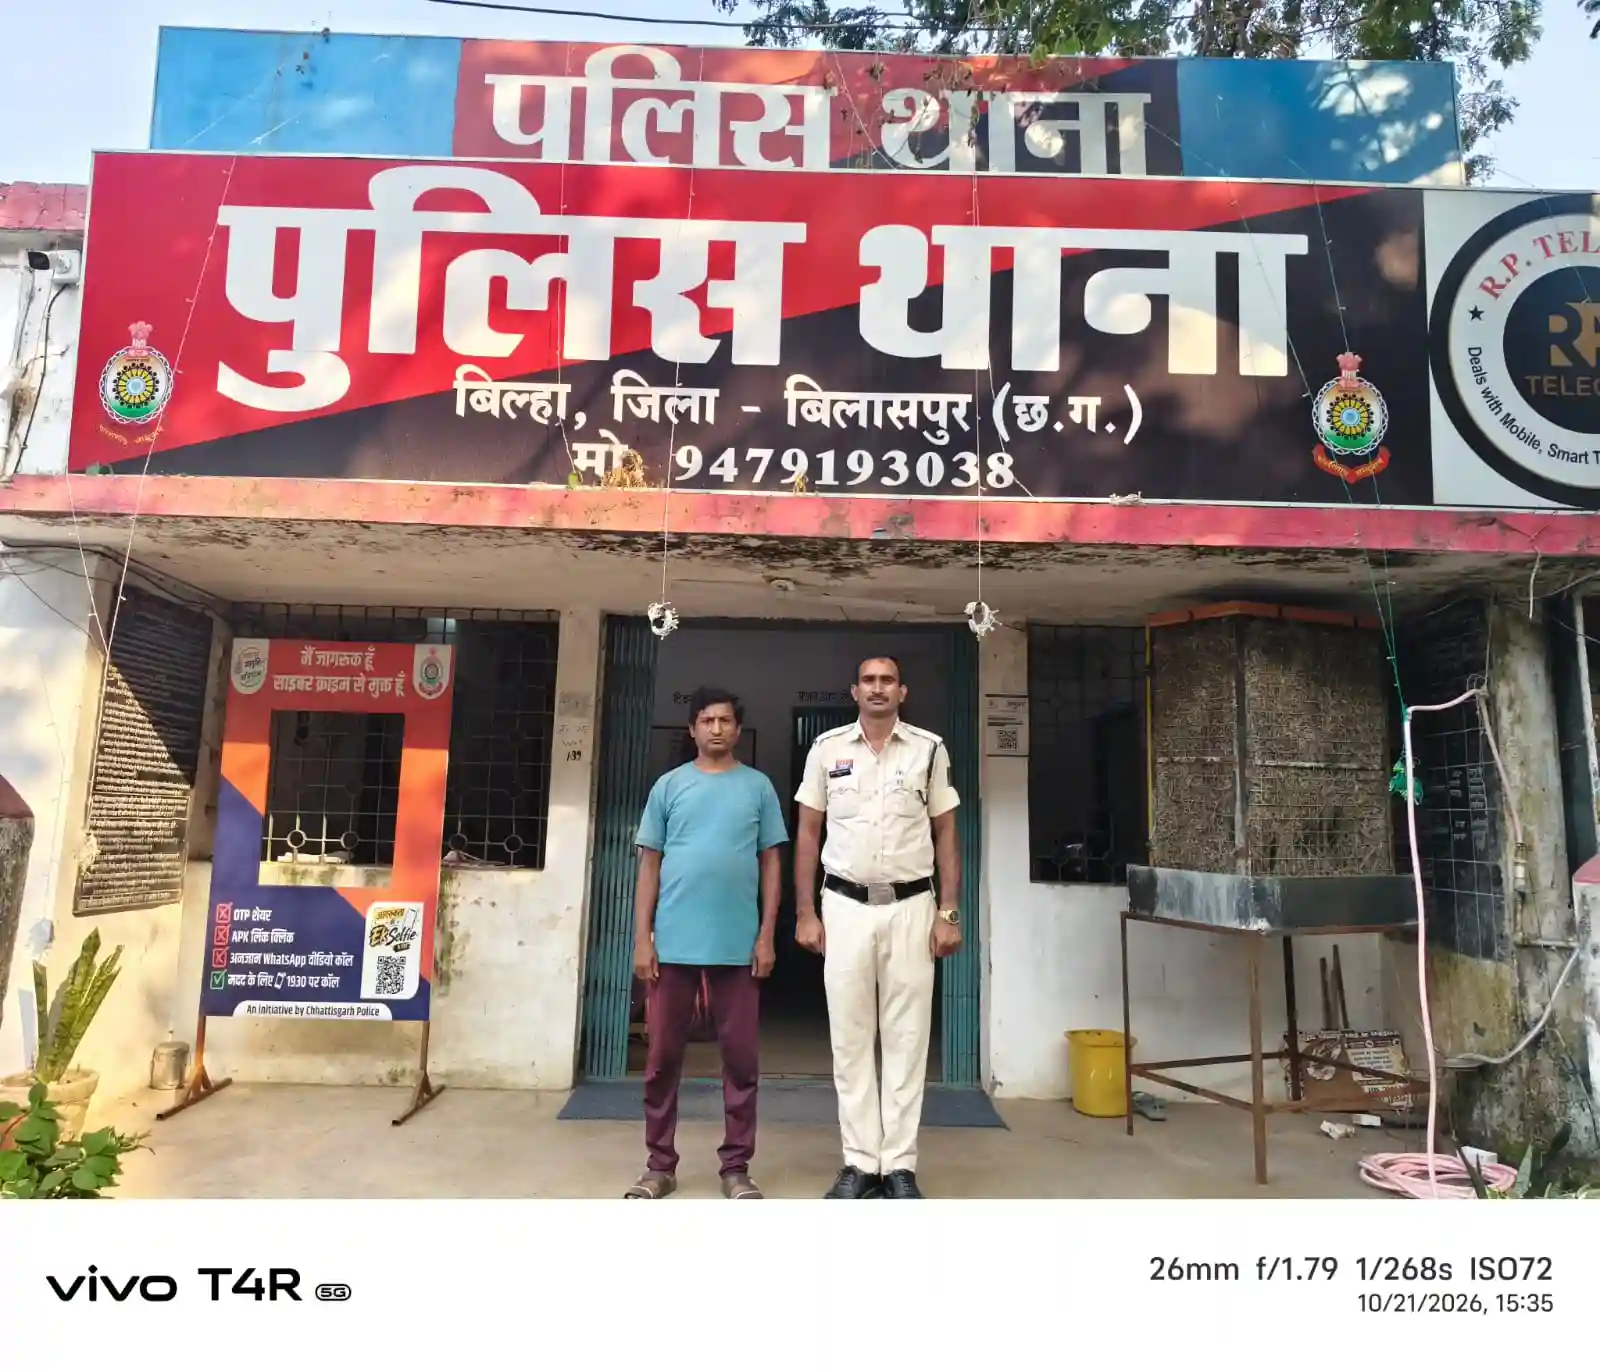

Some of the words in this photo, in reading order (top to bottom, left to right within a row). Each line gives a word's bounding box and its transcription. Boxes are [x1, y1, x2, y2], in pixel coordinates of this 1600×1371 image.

[881, 87, 1151, 175] थाना
[217, 166, 806, 411] पुलिस
[859, 224, 1308, 376] थाना
[453, 363, 587, 430] बिल्हा,
[610, 369, 720, 425] जिला
[784, 374, 972, 446] बिलासपुर
[992, 382, 1143, 445] (छ.ग.)
[1467, 346, 1487, 385] Deals
[1481, 387, 1502, 416] with
[1500, 412, 1543, 454] Mobile,
[1548, 443, 1589, 464] Smart
[675, 445, 1014, 489] 9479193038
[352, 672, 365, 692] से
[233, 908, 250, 921] OTP
[251, 906, 272, 922] शेयर
[231, 930, 249, 943] APK
[230, 952, 262, 965] अनजान
[262, 952, 307, 967] WhatsApp
[335, 951, 354, 967] कॉल
[247, 970, 256, 987] के
[286, 975, 307, 988] 1930
[308, 976, 320, 988] पर
[321, 973, 340, 989] कॉल
[247, 1004, 257, 1015] An
[295, 1005, 304, 1017] by
[306, 1005, 355, 1017] Chhattisgarh
[356, 1006, 380, 1017] Police
